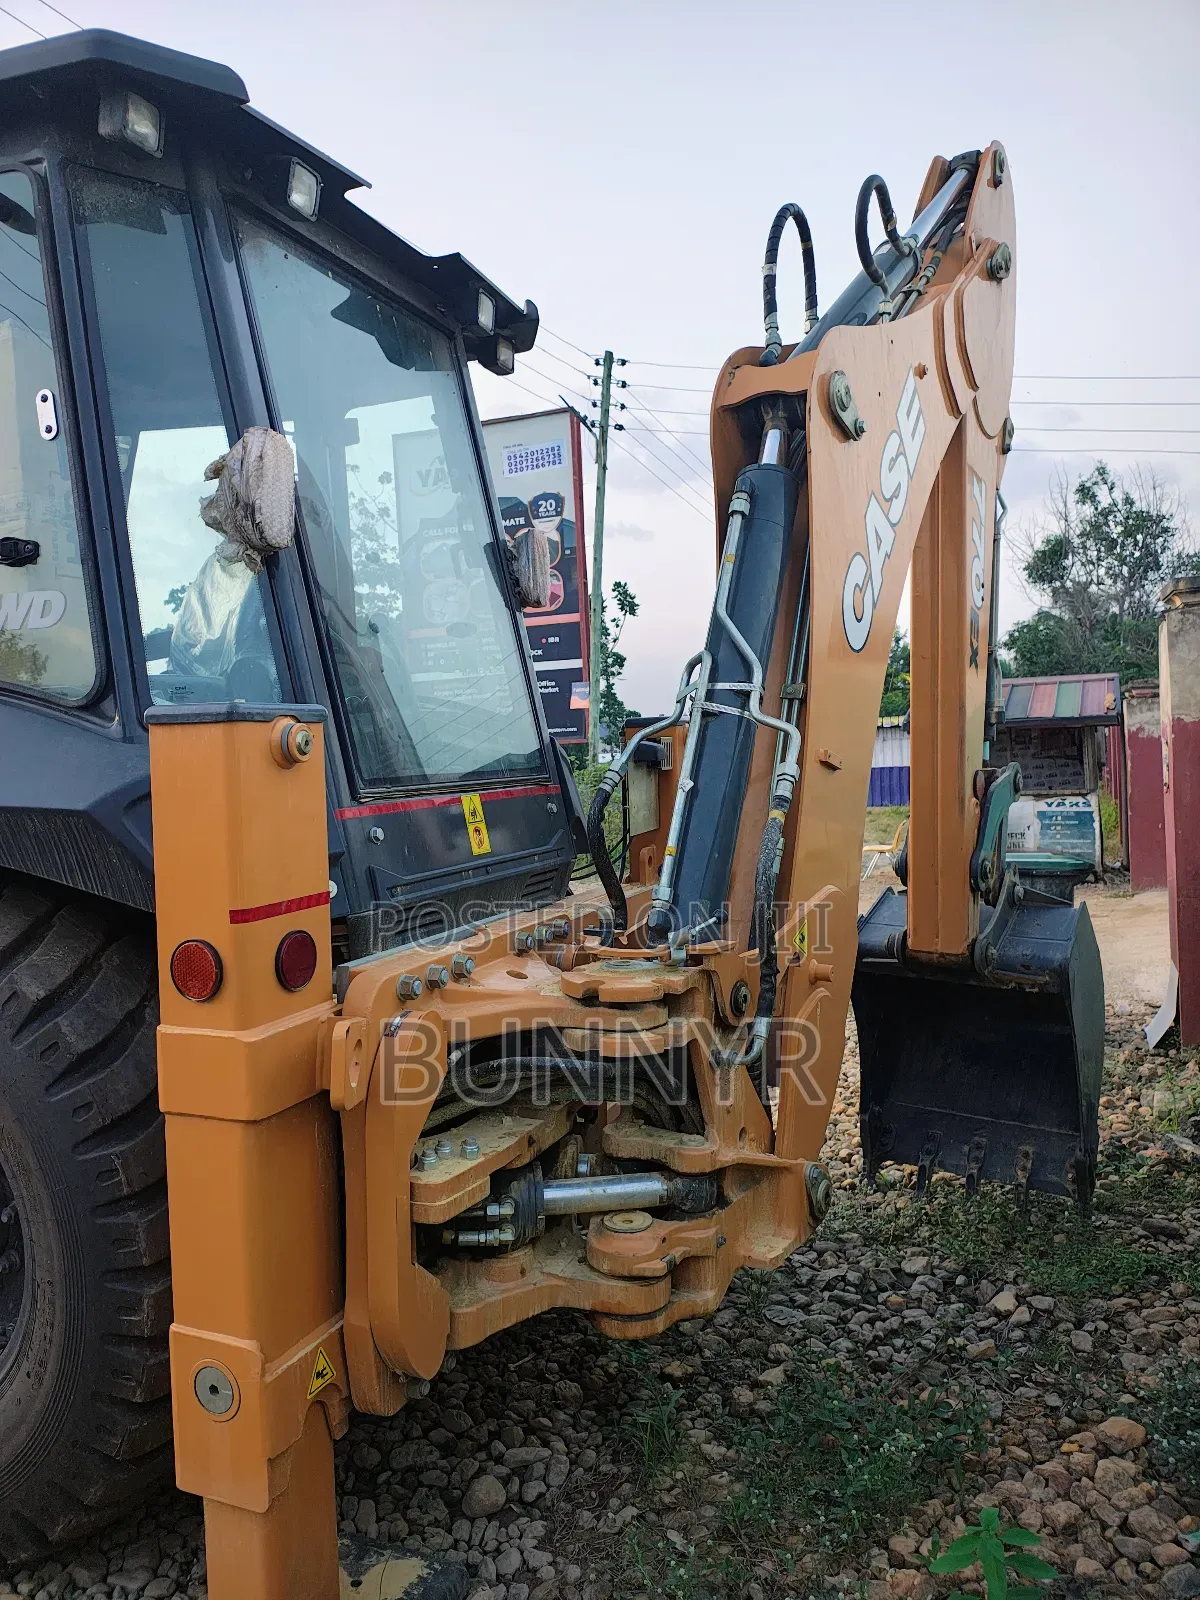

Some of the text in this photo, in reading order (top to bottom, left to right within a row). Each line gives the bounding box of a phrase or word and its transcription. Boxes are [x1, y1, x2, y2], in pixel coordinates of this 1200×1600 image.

[507, 445, 561, 461] 0542012282
[508, 452, 562, 467] 0207266735
[508, 458, 562, 474] 0207266782
[538, 499, 556, 512] 20
[842, 363, 926, 653] CASE
